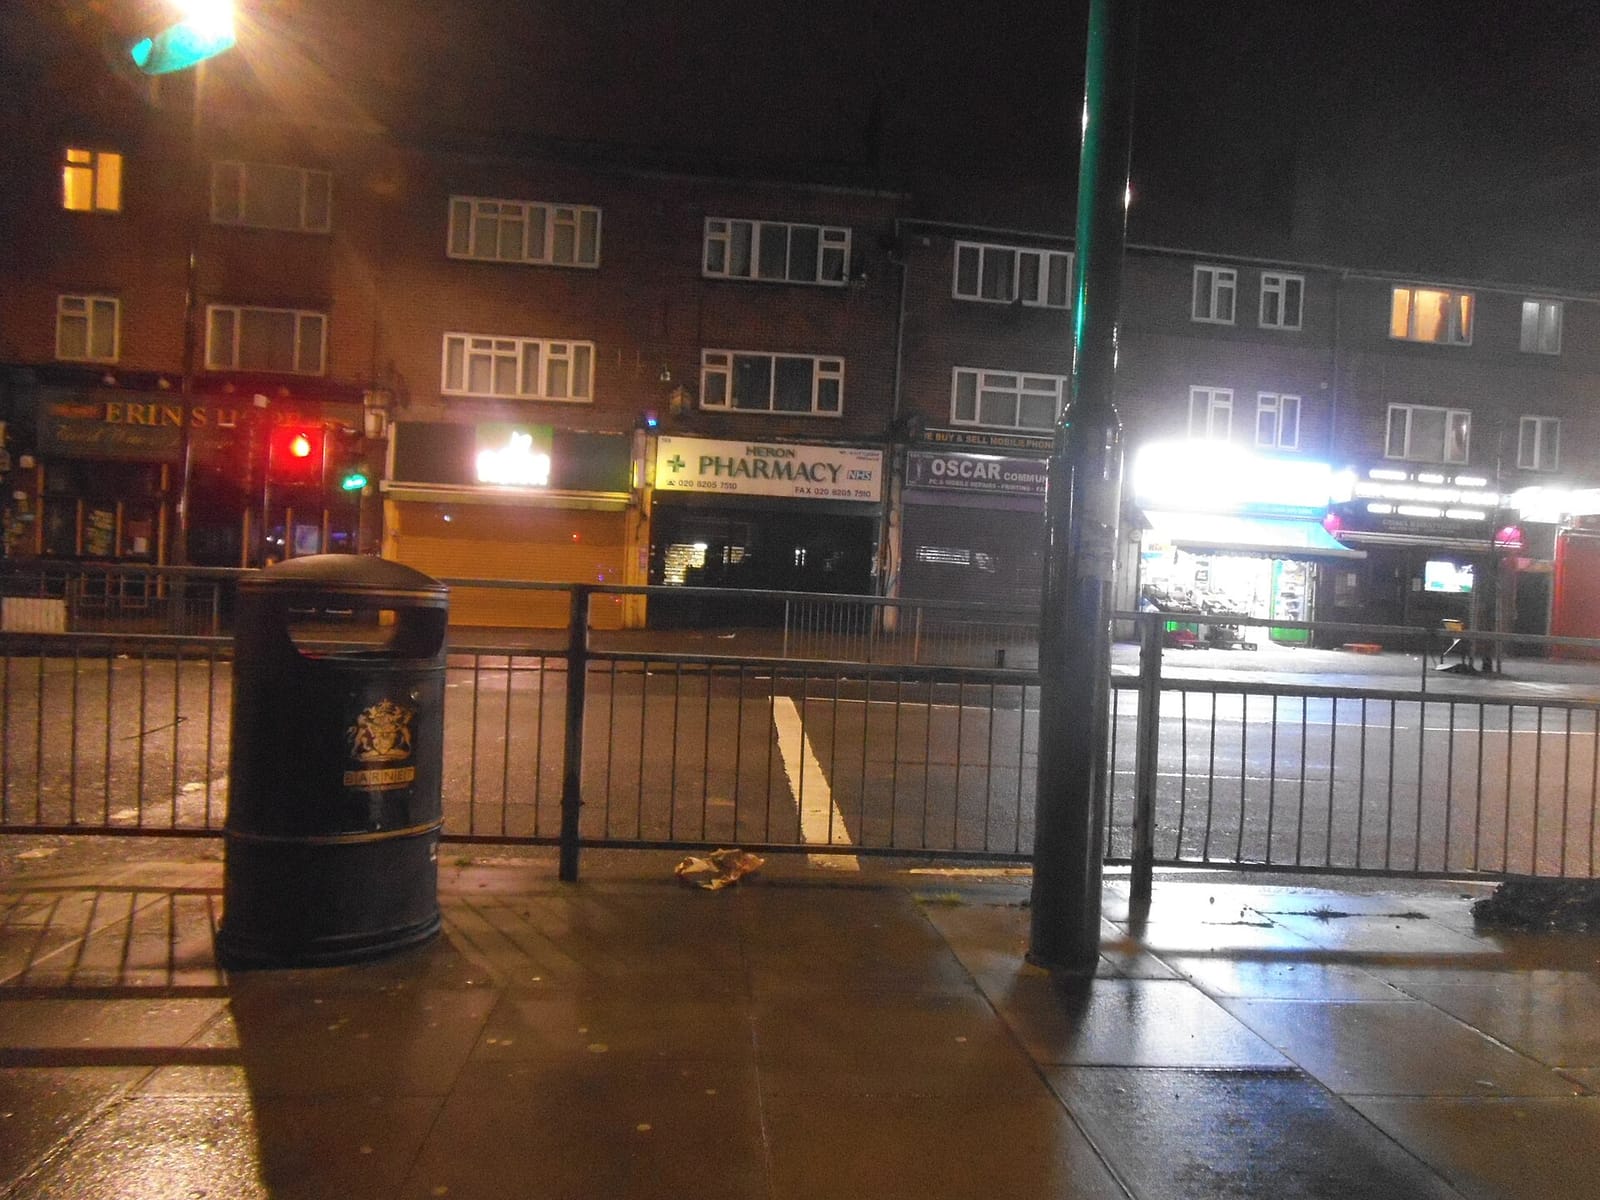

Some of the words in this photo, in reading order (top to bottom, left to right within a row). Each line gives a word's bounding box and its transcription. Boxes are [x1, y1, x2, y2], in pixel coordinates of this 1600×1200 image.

[935, 432, 954, 441] BUY
[966, 434, 988, 444] SELL
[990, 437, 1025, 447] MOBILE
[746, 445, 795, 458] HERON
[699, 455, 842, 483] PHARMACY
[847, 470, 872, 480] NHS
[931, 459, 1001, 480] OSCAR
[795, 486, 811, 494] FAX
[814, 487, 829, 495] 020
[832, 489, 851, 497] 8205
